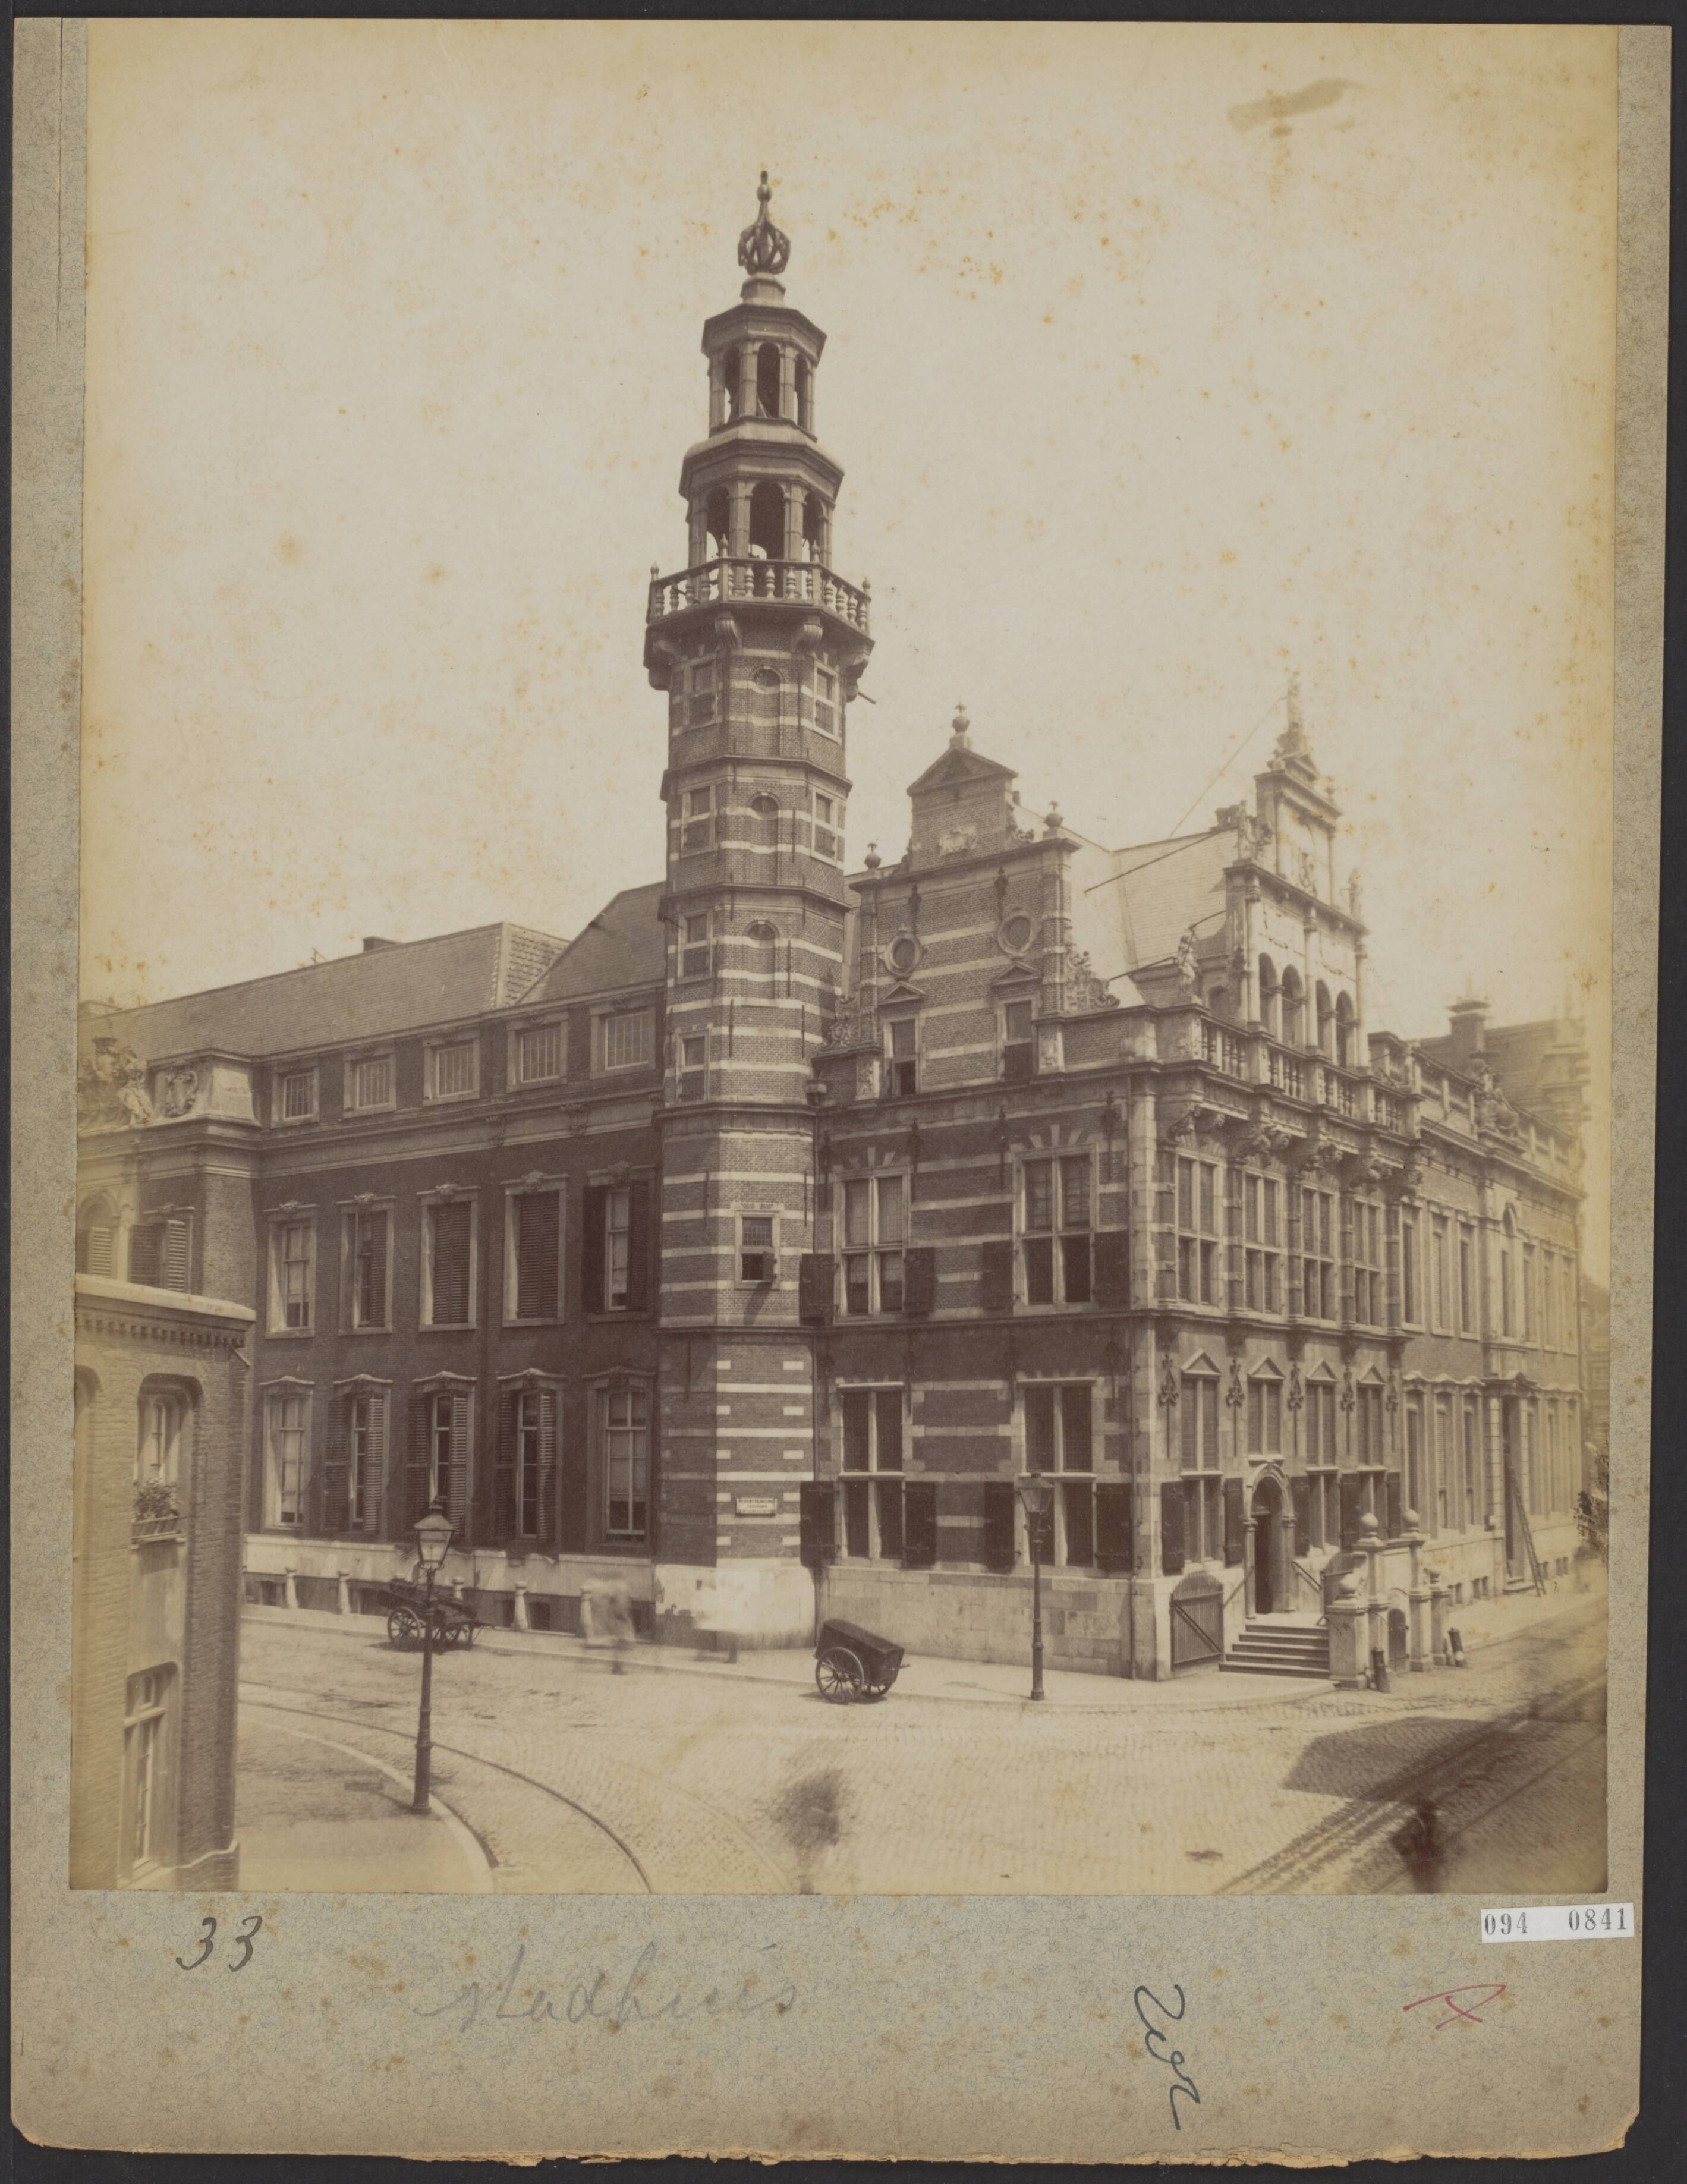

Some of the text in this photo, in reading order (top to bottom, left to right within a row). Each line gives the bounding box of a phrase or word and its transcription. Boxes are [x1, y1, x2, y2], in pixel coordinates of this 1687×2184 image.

[1485, 1908, 1627, 1935] 094 0841
[175, 1915, 263, 1972] 33
